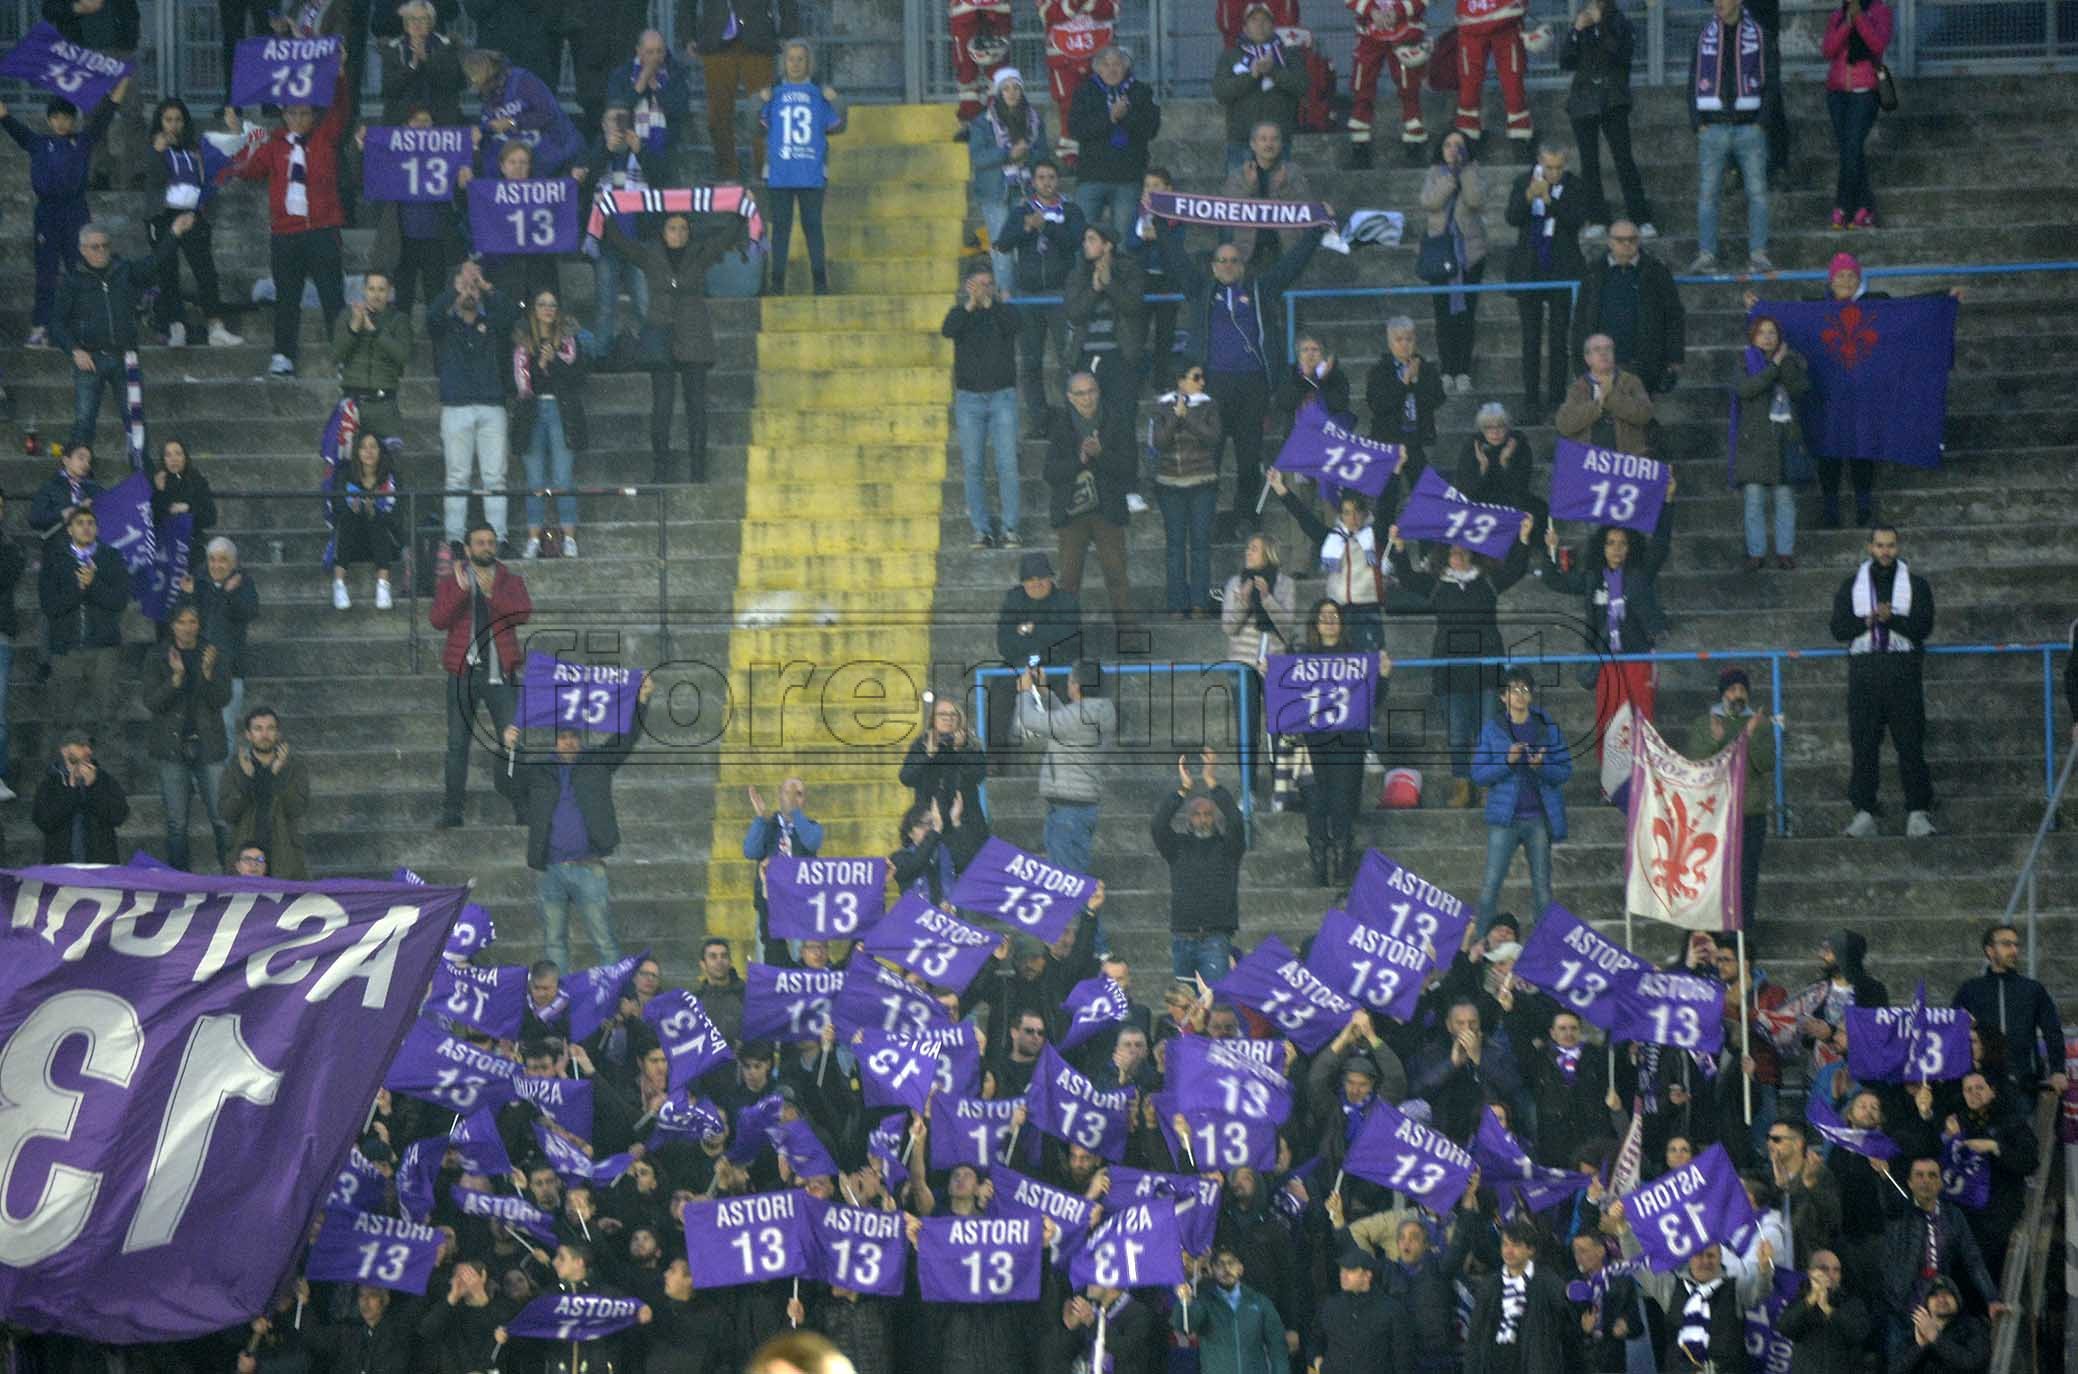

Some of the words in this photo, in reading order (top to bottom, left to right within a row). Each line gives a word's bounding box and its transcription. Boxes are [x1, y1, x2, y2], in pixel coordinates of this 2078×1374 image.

[50, 39, 125, 77] ASTORI
[263, 38, 336, 61] ASTORI
[270, 62, 315, 98] 13
[389, 129, 462, 152] ASTORI
[779, 104, 813, 145] 13
[401, 157, 449, 196] 13
[494, 181, 566, 204] ASTORI
[506, 209, 555, 246] 13
[1174, 197, 1312, 223] FIORENTINA
[1321, 446, 1372, 481] 13
[1583, 449, 1660, 481] ASTORI
[1588, 480, 1641, 522] 13
[1445, 509, 1498, 544] 13
[1291, 655, 1367, 682] ASTORI
[561, 688, 611, 724] 13
[1301, 685, 1349, 726] 13
[796, 861, 873, 885] ASTORI
[1004, 853, 1085, 898] ASTORI
[1387, 866, 1463, 918] ASTORI
[808, 891, 859, 933] 13
[998, 885, 1053, 925] 13
[905, 936, 958, 978] 13
[1348, 924, 1426, 971] ASTORI
[1349, 960, 1400, 1007] 13
[1554, 958, 1608, 1008] 13
[785, 997, 832, 1036] 13
[1260, 988, 1316, 1030] 13
[1649, 1004, 1702, 1048] 13
[431, 1068, 487, 1107] 13
[1056, 1067, 1128, 1111] ASTORI
[1217, 1075, 1270, 1118] 13
[1059, 1101, 1108, 1149] 13
[1197, 1121, 1249, 1166] 13
[1395, 1117, 1472, 1170] ASTORI
[1389, 1153, 1446, 1195] 13
[717, 1193, 794, 1228] ASTORI
[1014, 1179, 1085, 1224] ASTORI
[353, 1211, 433, 1243] ASTORI
[823, 1206, 899, 1239] ASTORI
[949, 1219, 1029, 1245] ASTORI
[357, 1241, 411, 1282] 13
[732, 1226, 786, 1276] 13
[832, 1238, 882, 1286] 13
[961, 1250, 1014, 1295] 13
